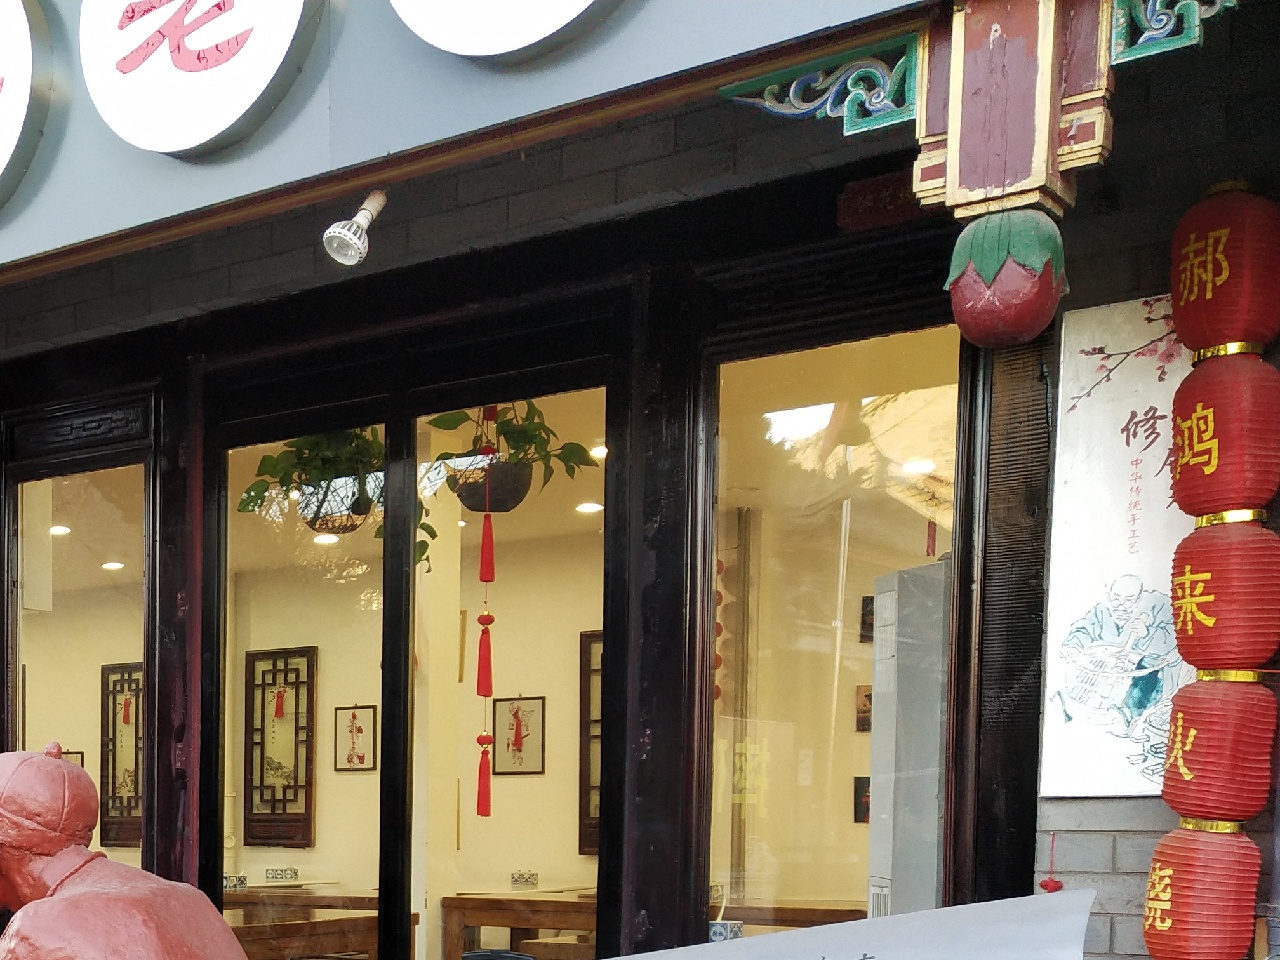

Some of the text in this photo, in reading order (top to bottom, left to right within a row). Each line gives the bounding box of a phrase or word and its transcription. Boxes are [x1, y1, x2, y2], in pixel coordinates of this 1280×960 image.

[1127, 457, 1143, 554] 中华传统手工艺
